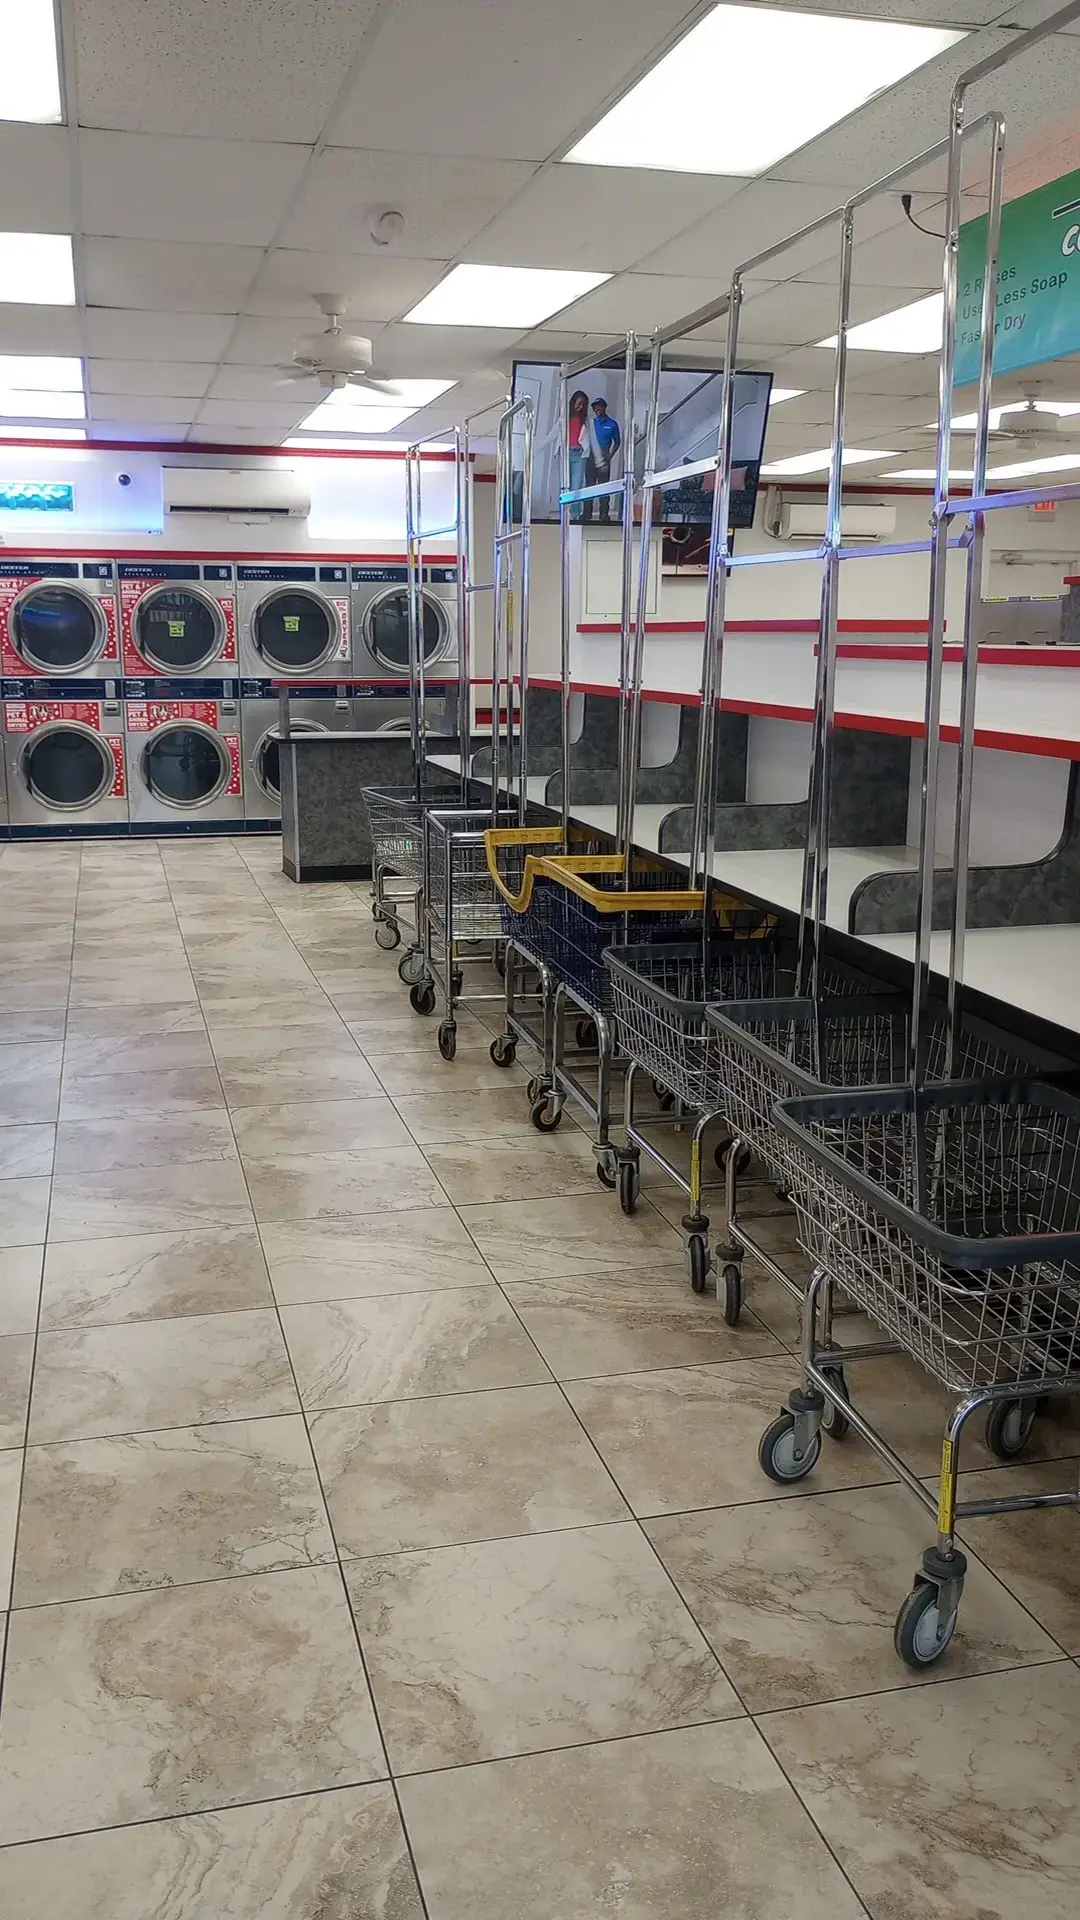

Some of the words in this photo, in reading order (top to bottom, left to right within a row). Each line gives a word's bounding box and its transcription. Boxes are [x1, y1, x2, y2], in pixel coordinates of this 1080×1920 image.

[963, 282, 971, 298] 2
[974, 266, 1017, 293] Rses
[996, 286, 1027, 307] Less
[1031, 271, 1068, 294] Soap
[961, 322, 1000, 346] Fasr
[1004, 313, 1027, 331] Dry
